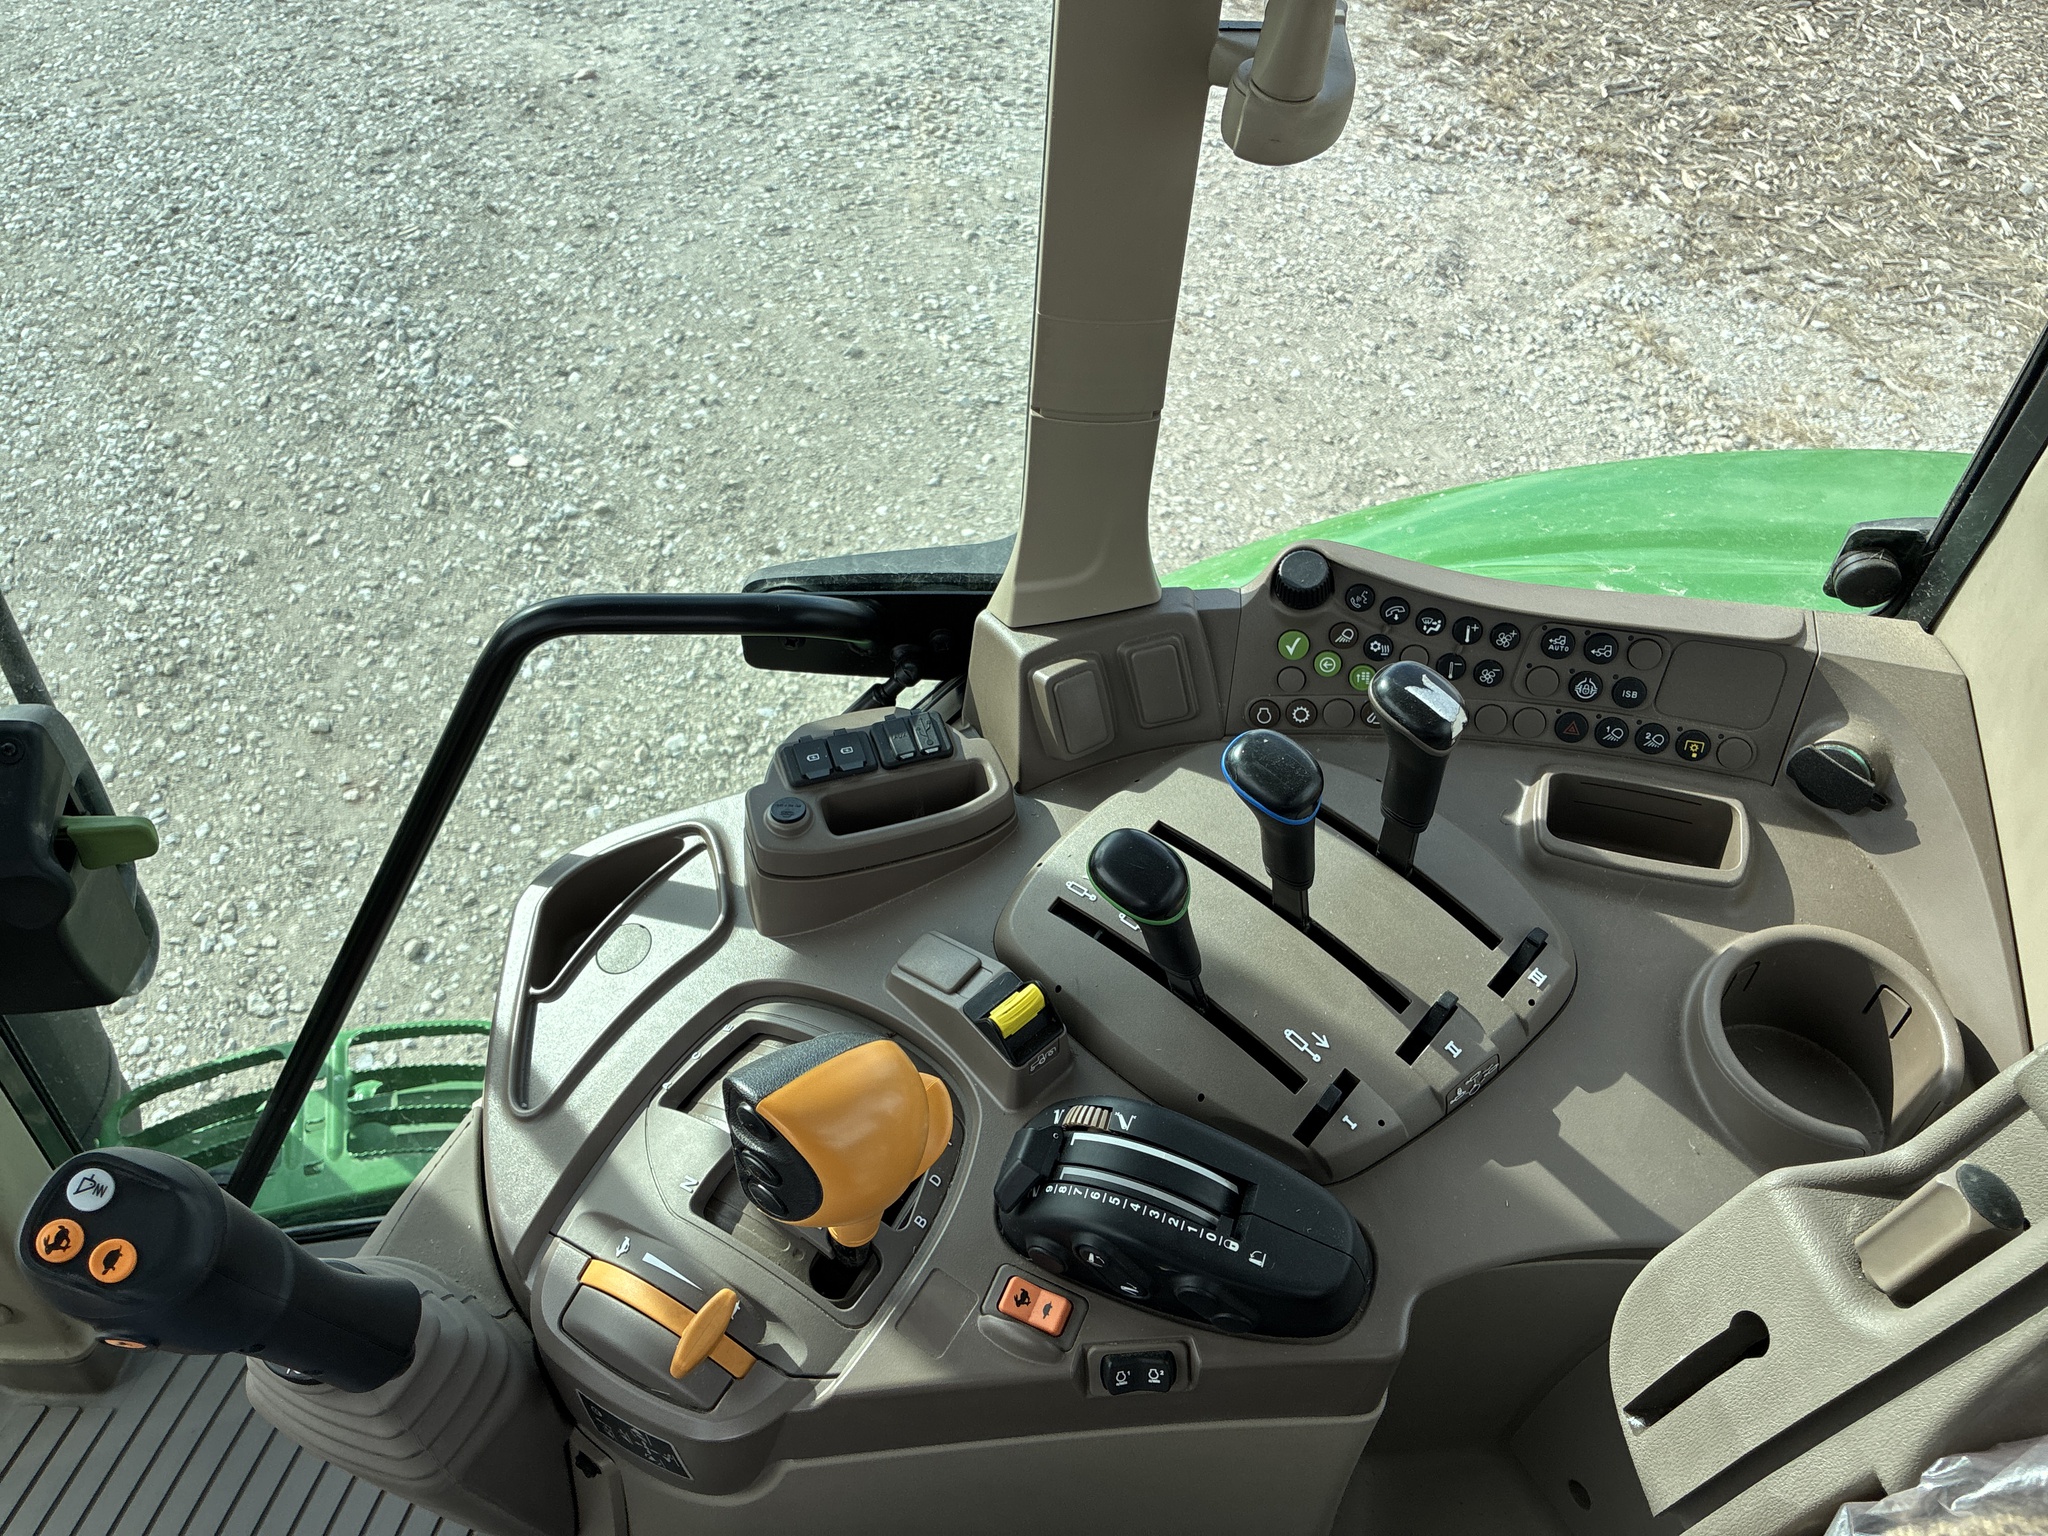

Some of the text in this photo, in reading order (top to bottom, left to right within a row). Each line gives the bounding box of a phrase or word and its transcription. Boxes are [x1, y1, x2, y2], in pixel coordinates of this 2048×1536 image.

[1622, 690, 1637, 698] ISB
[1528, 967, 1547, 987] III
[1444, 1040, 1462, 1058] II
[680, 1175, 698, 1193] N
[929, 1174, 941, 1187] D
[914, 1215, 927, 1229] B
[1073, 1187, 1082, 1195] 7
[1090, 1191, 1100, 1200] 6
[1109, 1196, 1120, 1205] 5
[1130, 1202, 1141, 1211] 4
[1149, 1209, 1160, 1219] 3
[1168, 1217, 1179, 1227] 2
[1206, 1232, 1216, 1242] 0
